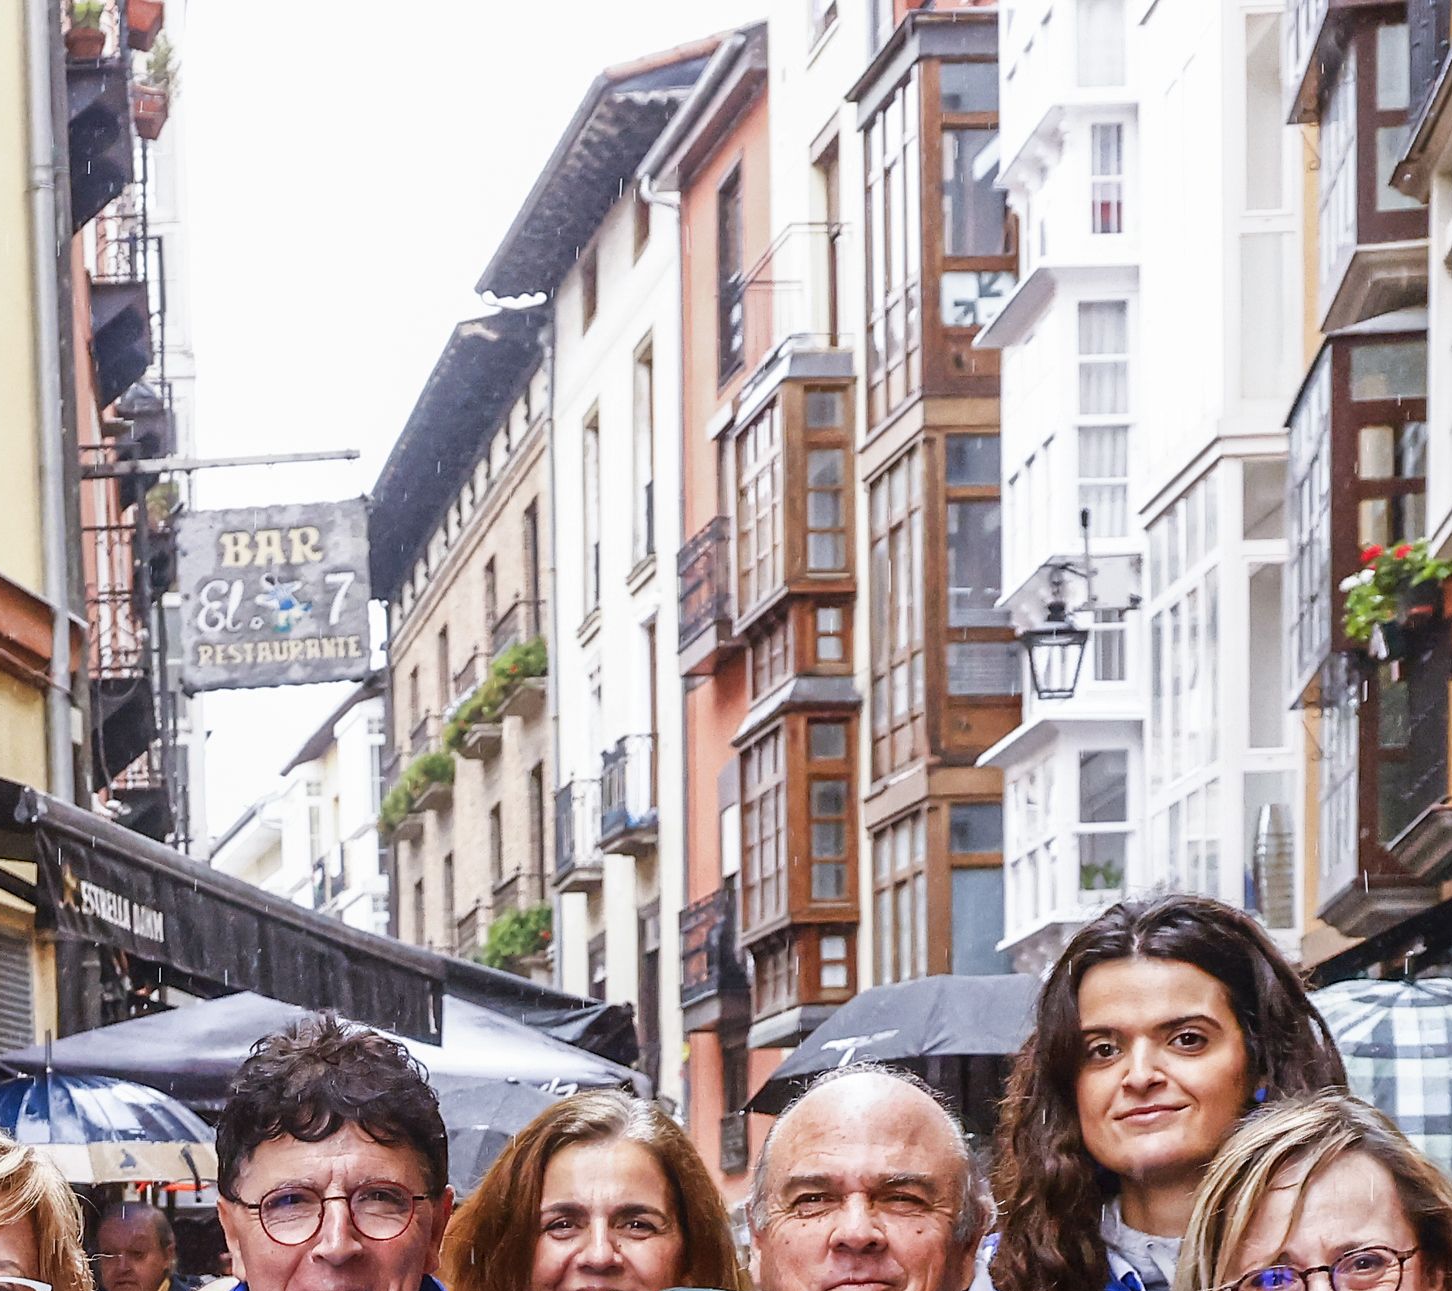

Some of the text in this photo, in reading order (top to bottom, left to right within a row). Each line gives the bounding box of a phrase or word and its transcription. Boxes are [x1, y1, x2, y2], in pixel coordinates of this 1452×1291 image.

[219, 526, 324, 568] BAR
[324, 571, 356, 626] 7
[198, 634, 362, 667] RESTAURANTE
